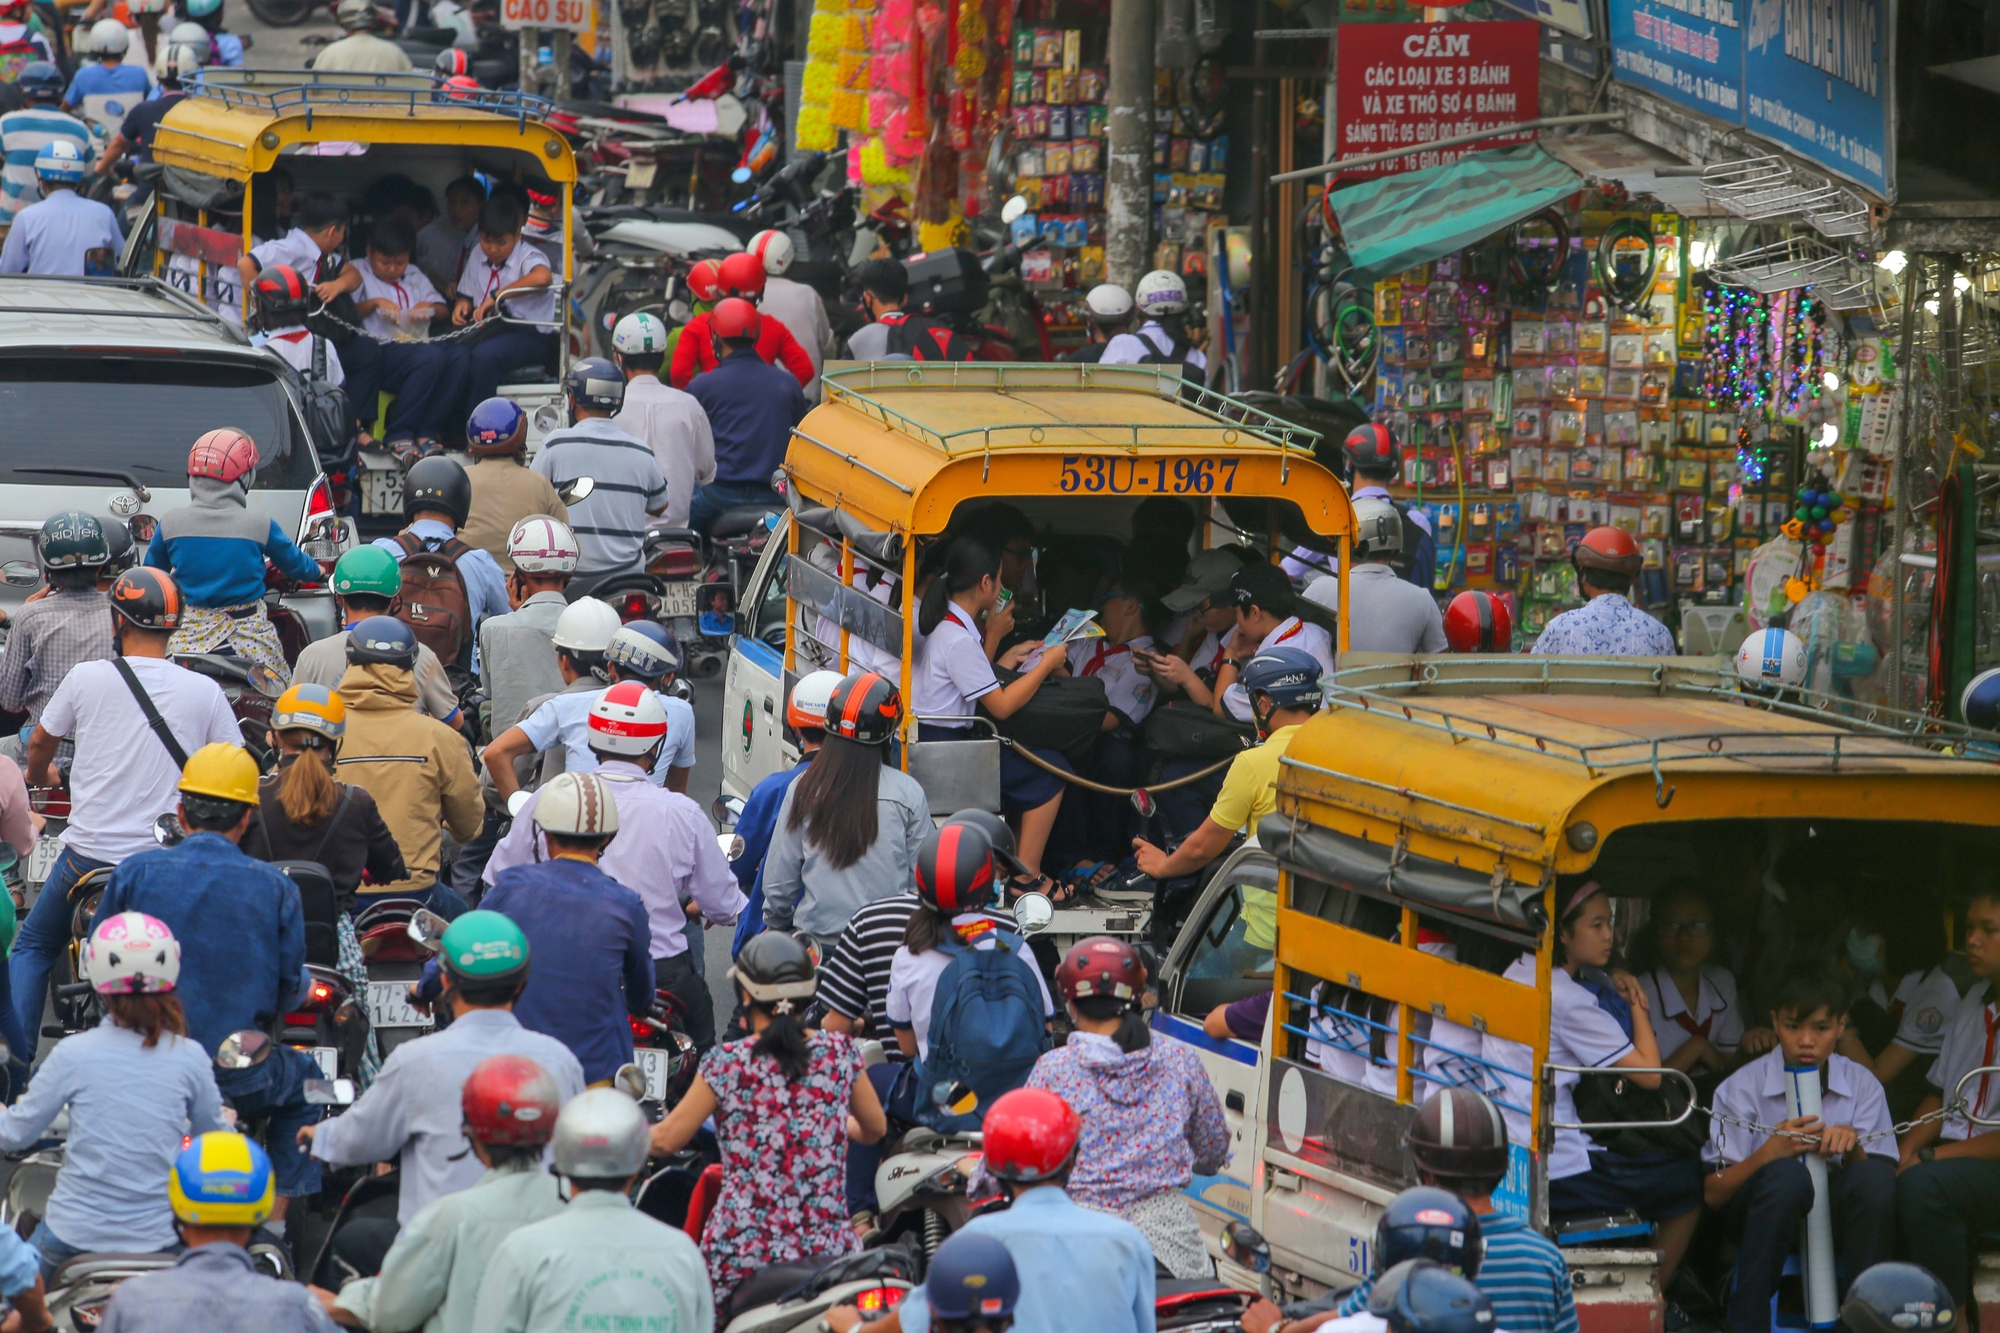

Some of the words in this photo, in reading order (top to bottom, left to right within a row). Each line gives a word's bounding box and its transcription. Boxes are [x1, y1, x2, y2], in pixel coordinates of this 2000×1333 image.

[505, 0, 549, 21] CAO
[556, 0, 583, 24] SU
[1403, 26, 1470, 57] CẤM
[1365, 62, 1395, 86] CÁC
[1398, 66, 1431, 90] LOẠI
[1435, 66, 1453, 85] XE
[1457, 66, 1466, 85] 3
[1470, 61, 1510, 84] BÁNH
[1362, 90, 1382, 114] VÀ
[1386, 95, 1404, 114] XE
[1408, 90, 1438, 114] THÔ
[1441, 91, 1461, 113] SƠ
[1464, 95, 1472, 113] 4
[1476, 89, 1516, 112] BÁNH
[1346, 119, 1377, 143] SÁNG
[1379, 119, 1398, 142] TỪ:
[1400, 123, 1414, 142] 05
[1417, 118, 1437, 142] GIỜ
[1439, 123, 1453, 141] 00
[1455, 116, 1478, 137] ĐẾN
[1403, 154, 1417, 170] 16
[1060, 455, 1240, 494] 53U-1967
[380, 490, 402, 511] 17
[374, 1004, 424, 1024] 1422
[1226, 1196, 1250, 1214] CARRY
[1349, 1236, 1367, 1276] 51
